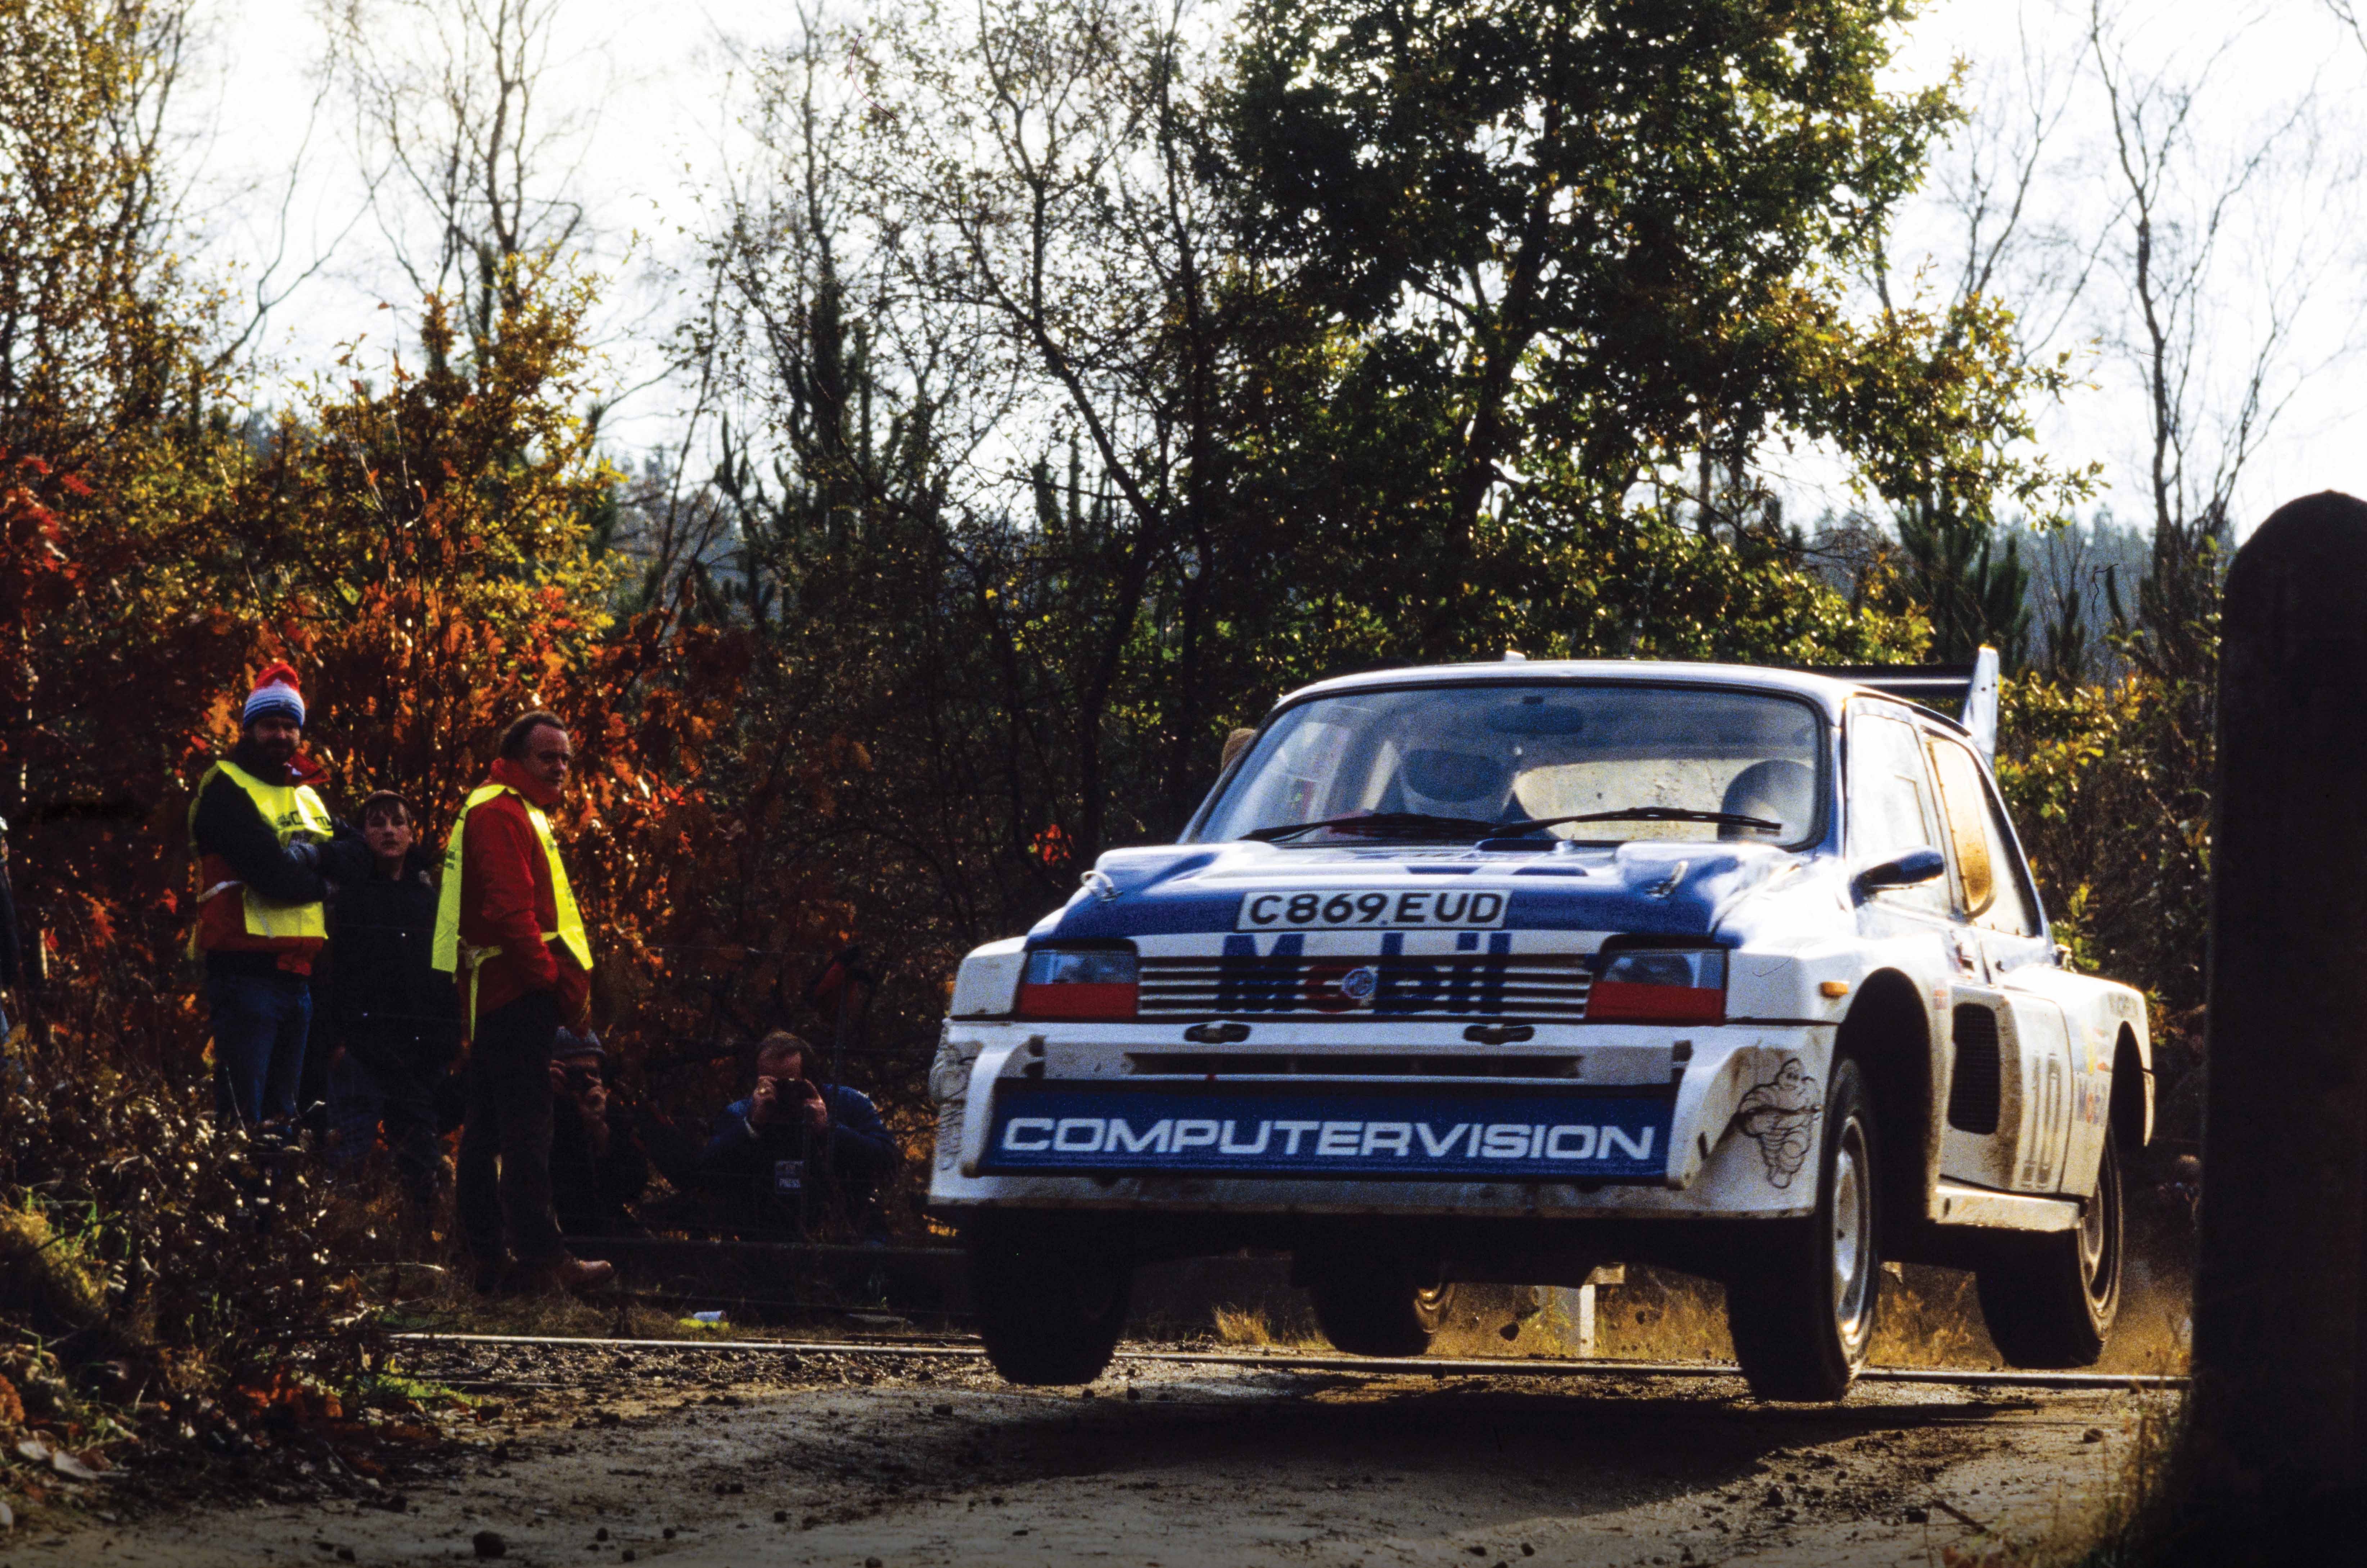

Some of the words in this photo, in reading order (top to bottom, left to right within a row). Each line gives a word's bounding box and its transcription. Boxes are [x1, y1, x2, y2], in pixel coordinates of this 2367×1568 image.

[1250, 893, 1388, 924] C869
[1394, 893, 1503, 923] EUD
[1002, 1117, 1654, 1159] COMPUTERVISION
